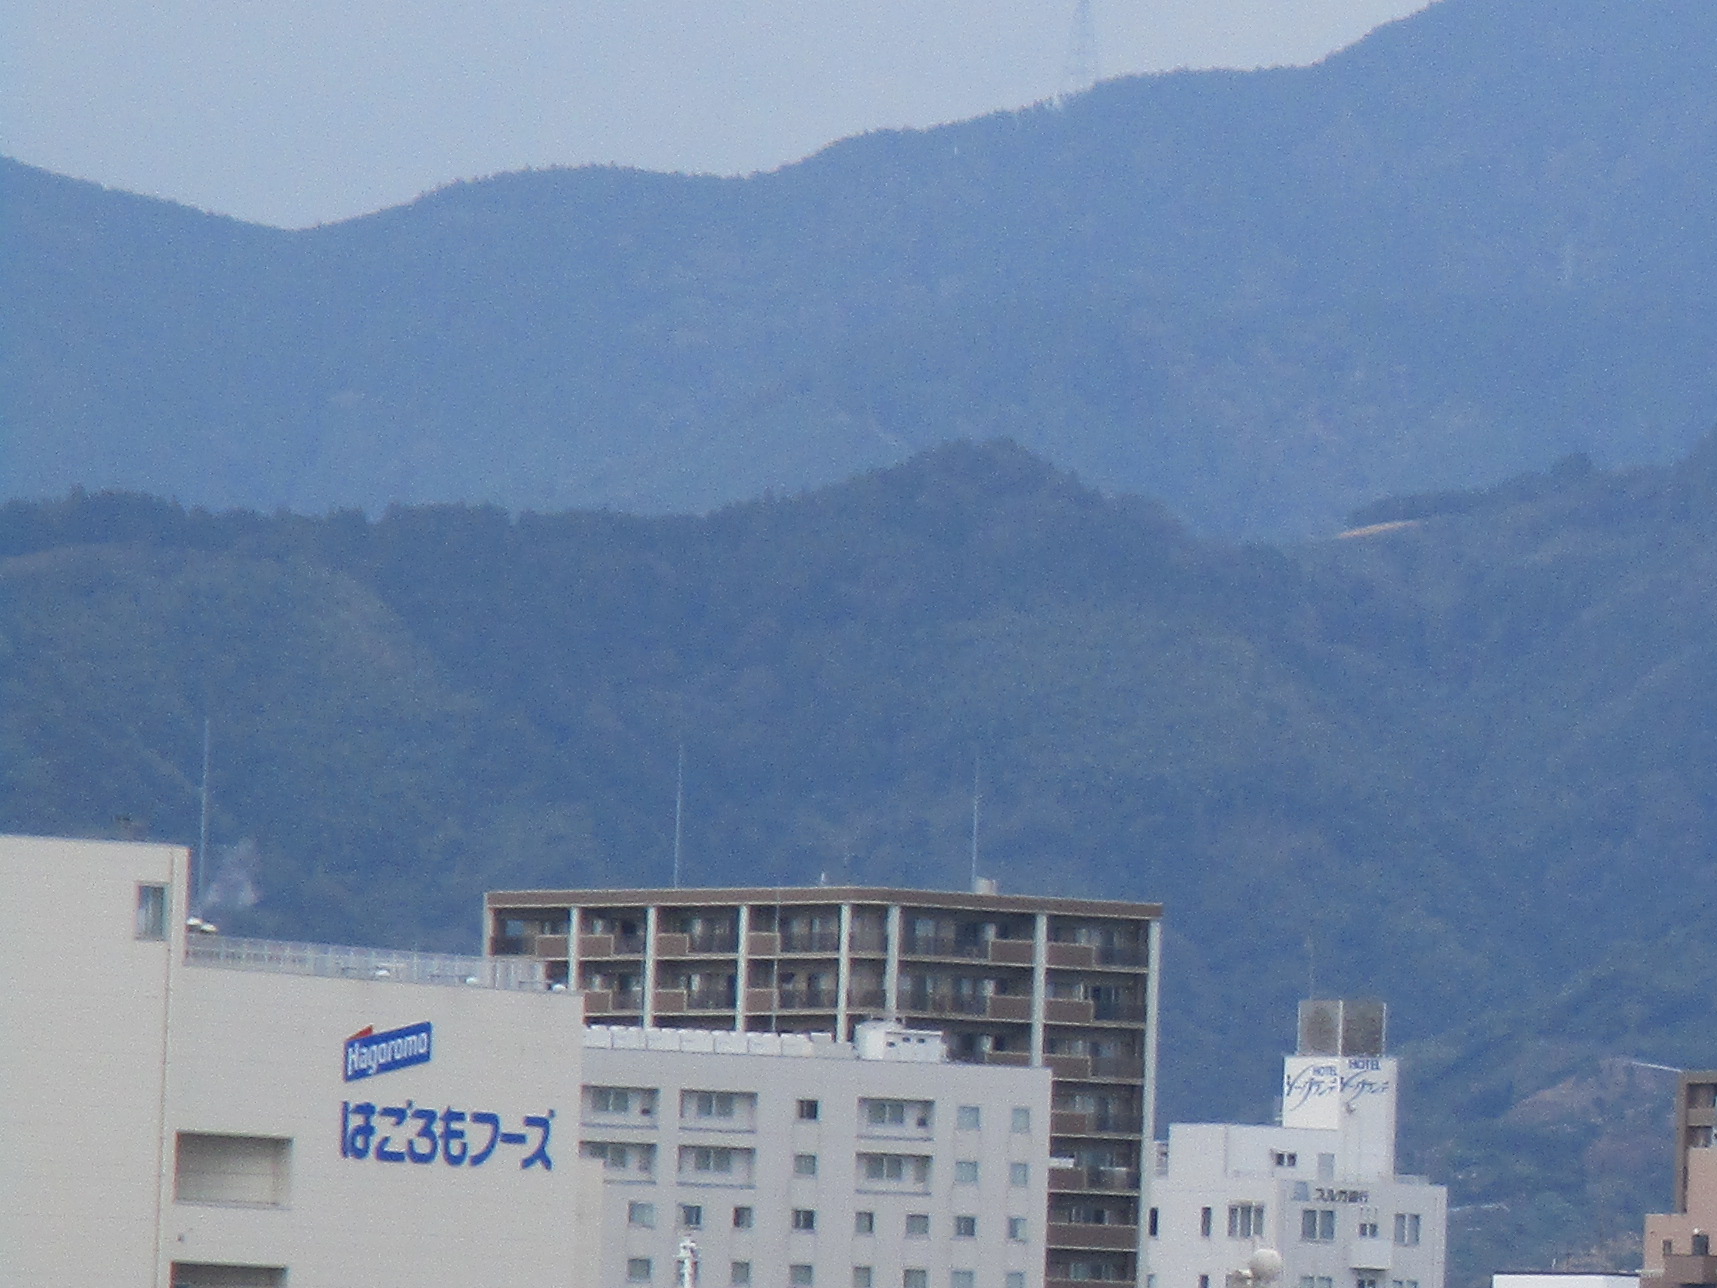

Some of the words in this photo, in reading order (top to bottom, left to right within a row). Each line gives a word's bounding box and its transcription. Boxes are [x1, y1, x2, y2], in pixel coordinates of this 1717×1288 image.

[346, 1030, 429, 1076] Hagoromo
[339, 1098, 557, 1172] はごろもフーズ
